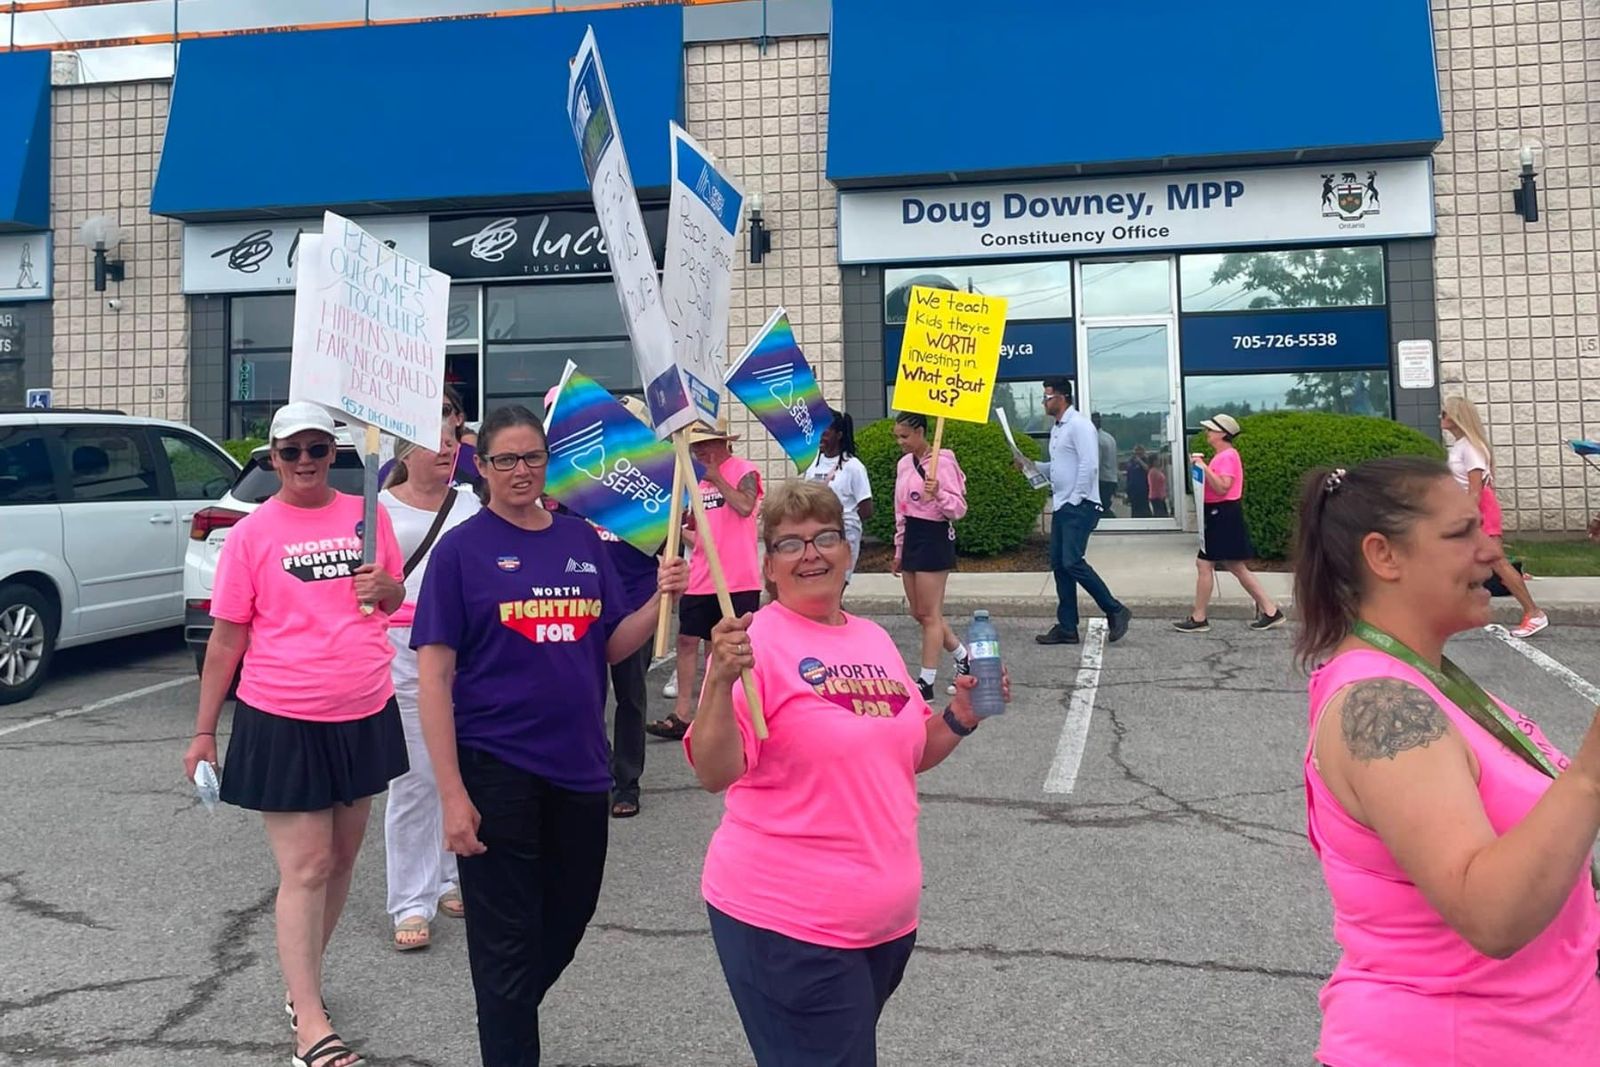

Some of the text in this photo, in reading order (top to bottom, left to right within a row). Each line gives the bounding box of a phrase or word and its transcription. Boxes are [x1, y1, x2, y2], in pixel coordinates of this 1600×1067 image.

[902, 180, 1245, 228] Doug Downey, MPP
[980, 225, 1170, 247] Constituency Office
[523, 264, 581, 273] TUSCAN
[916, 290, 989, 314] We teach
[948, 317, 990, 336] they're
[926, 332, 977, 355] WORTH
[999, 343, 1034, 360] ey.ca
[1232, 332, 1337, 349] 705-726-5538
[394, 335, 434, 371] WITH
[908, 346, 961, 372] investing
[239, 363, 250, 401] OPEN
[352, 347, 438, 399] NEGOTIATED
[902, 363, 986, 393] What about
[351, 369, 400, 407] DEALS!
[928, 388, 960, 407] us?
[614, 457, 672, 503] OPSEU
[602, 472, 660, 514] SEFPO
[283, 537, 361, 556] WORTH
[312, 563, 352, 579] FOR
[531, 586, 581, 597] WORTH
[499, 598, 602, 623] FIGHTING
[536, 623, 577, 643] FOR
[825, 663, 888, 679] WORTH
[815, 677, 910, 698] FIGHTING
[851, 699, 894, 718] FOR
